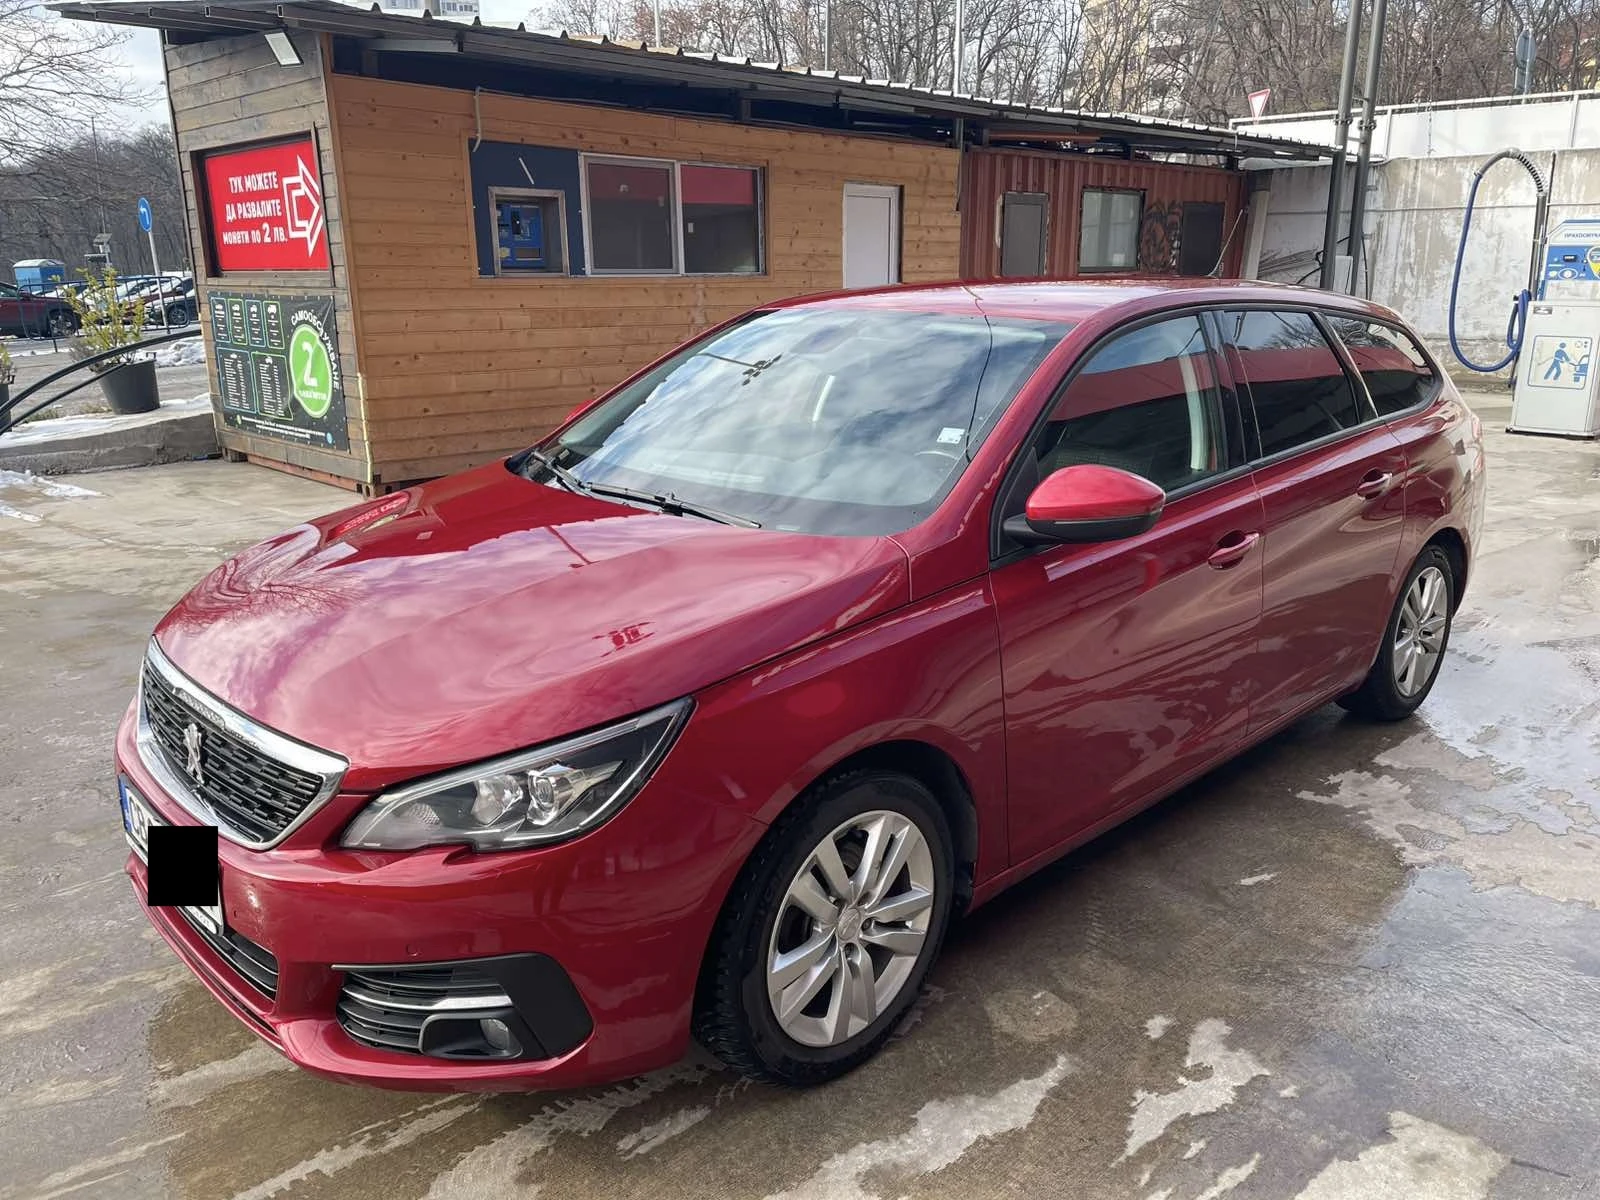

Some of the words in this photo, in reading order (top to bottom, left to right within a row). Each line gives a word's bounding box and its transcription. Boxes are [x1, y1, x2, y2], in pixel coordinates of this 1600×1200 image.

[228, 175, 244, 194] ТУК
[244, 171, 279, 191] МОЖЕТЕ
[225, 203, 237, 223] ДА
[236, 199, 282, 220] РАЗВАЛИТЕ
[262, 222, 272, 243] 2
[302, 341, 318, 388] 2
